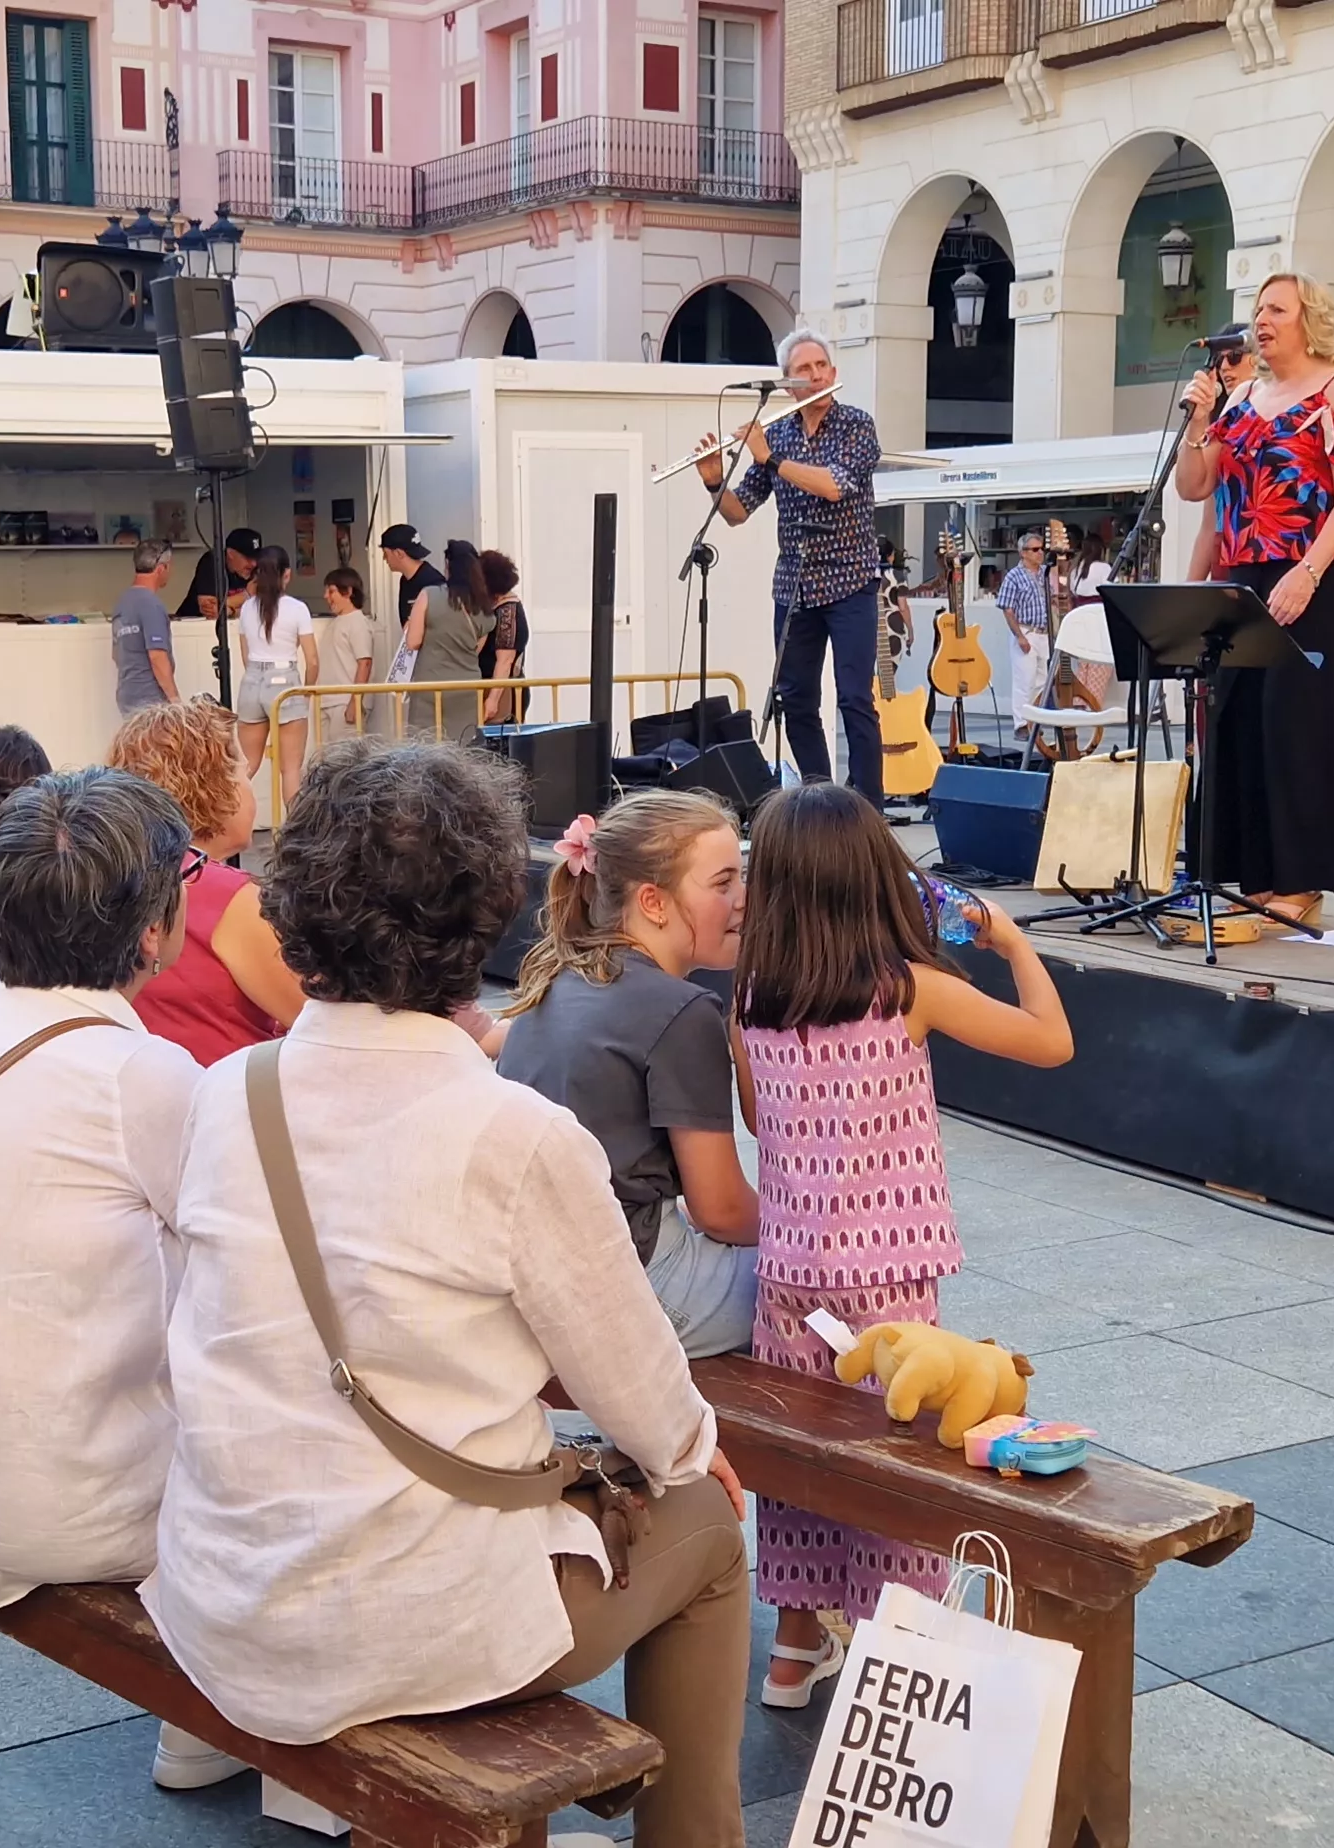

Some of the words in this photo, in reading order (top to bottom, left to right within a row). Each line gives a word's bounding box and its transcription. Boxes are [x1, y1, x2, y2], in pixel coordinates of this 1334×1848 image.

[854, 1656, 971, 1731] FERIA
[840, 1703, 916, 1768] DEL
[826, 1751, 953, 1828] LIBRO
